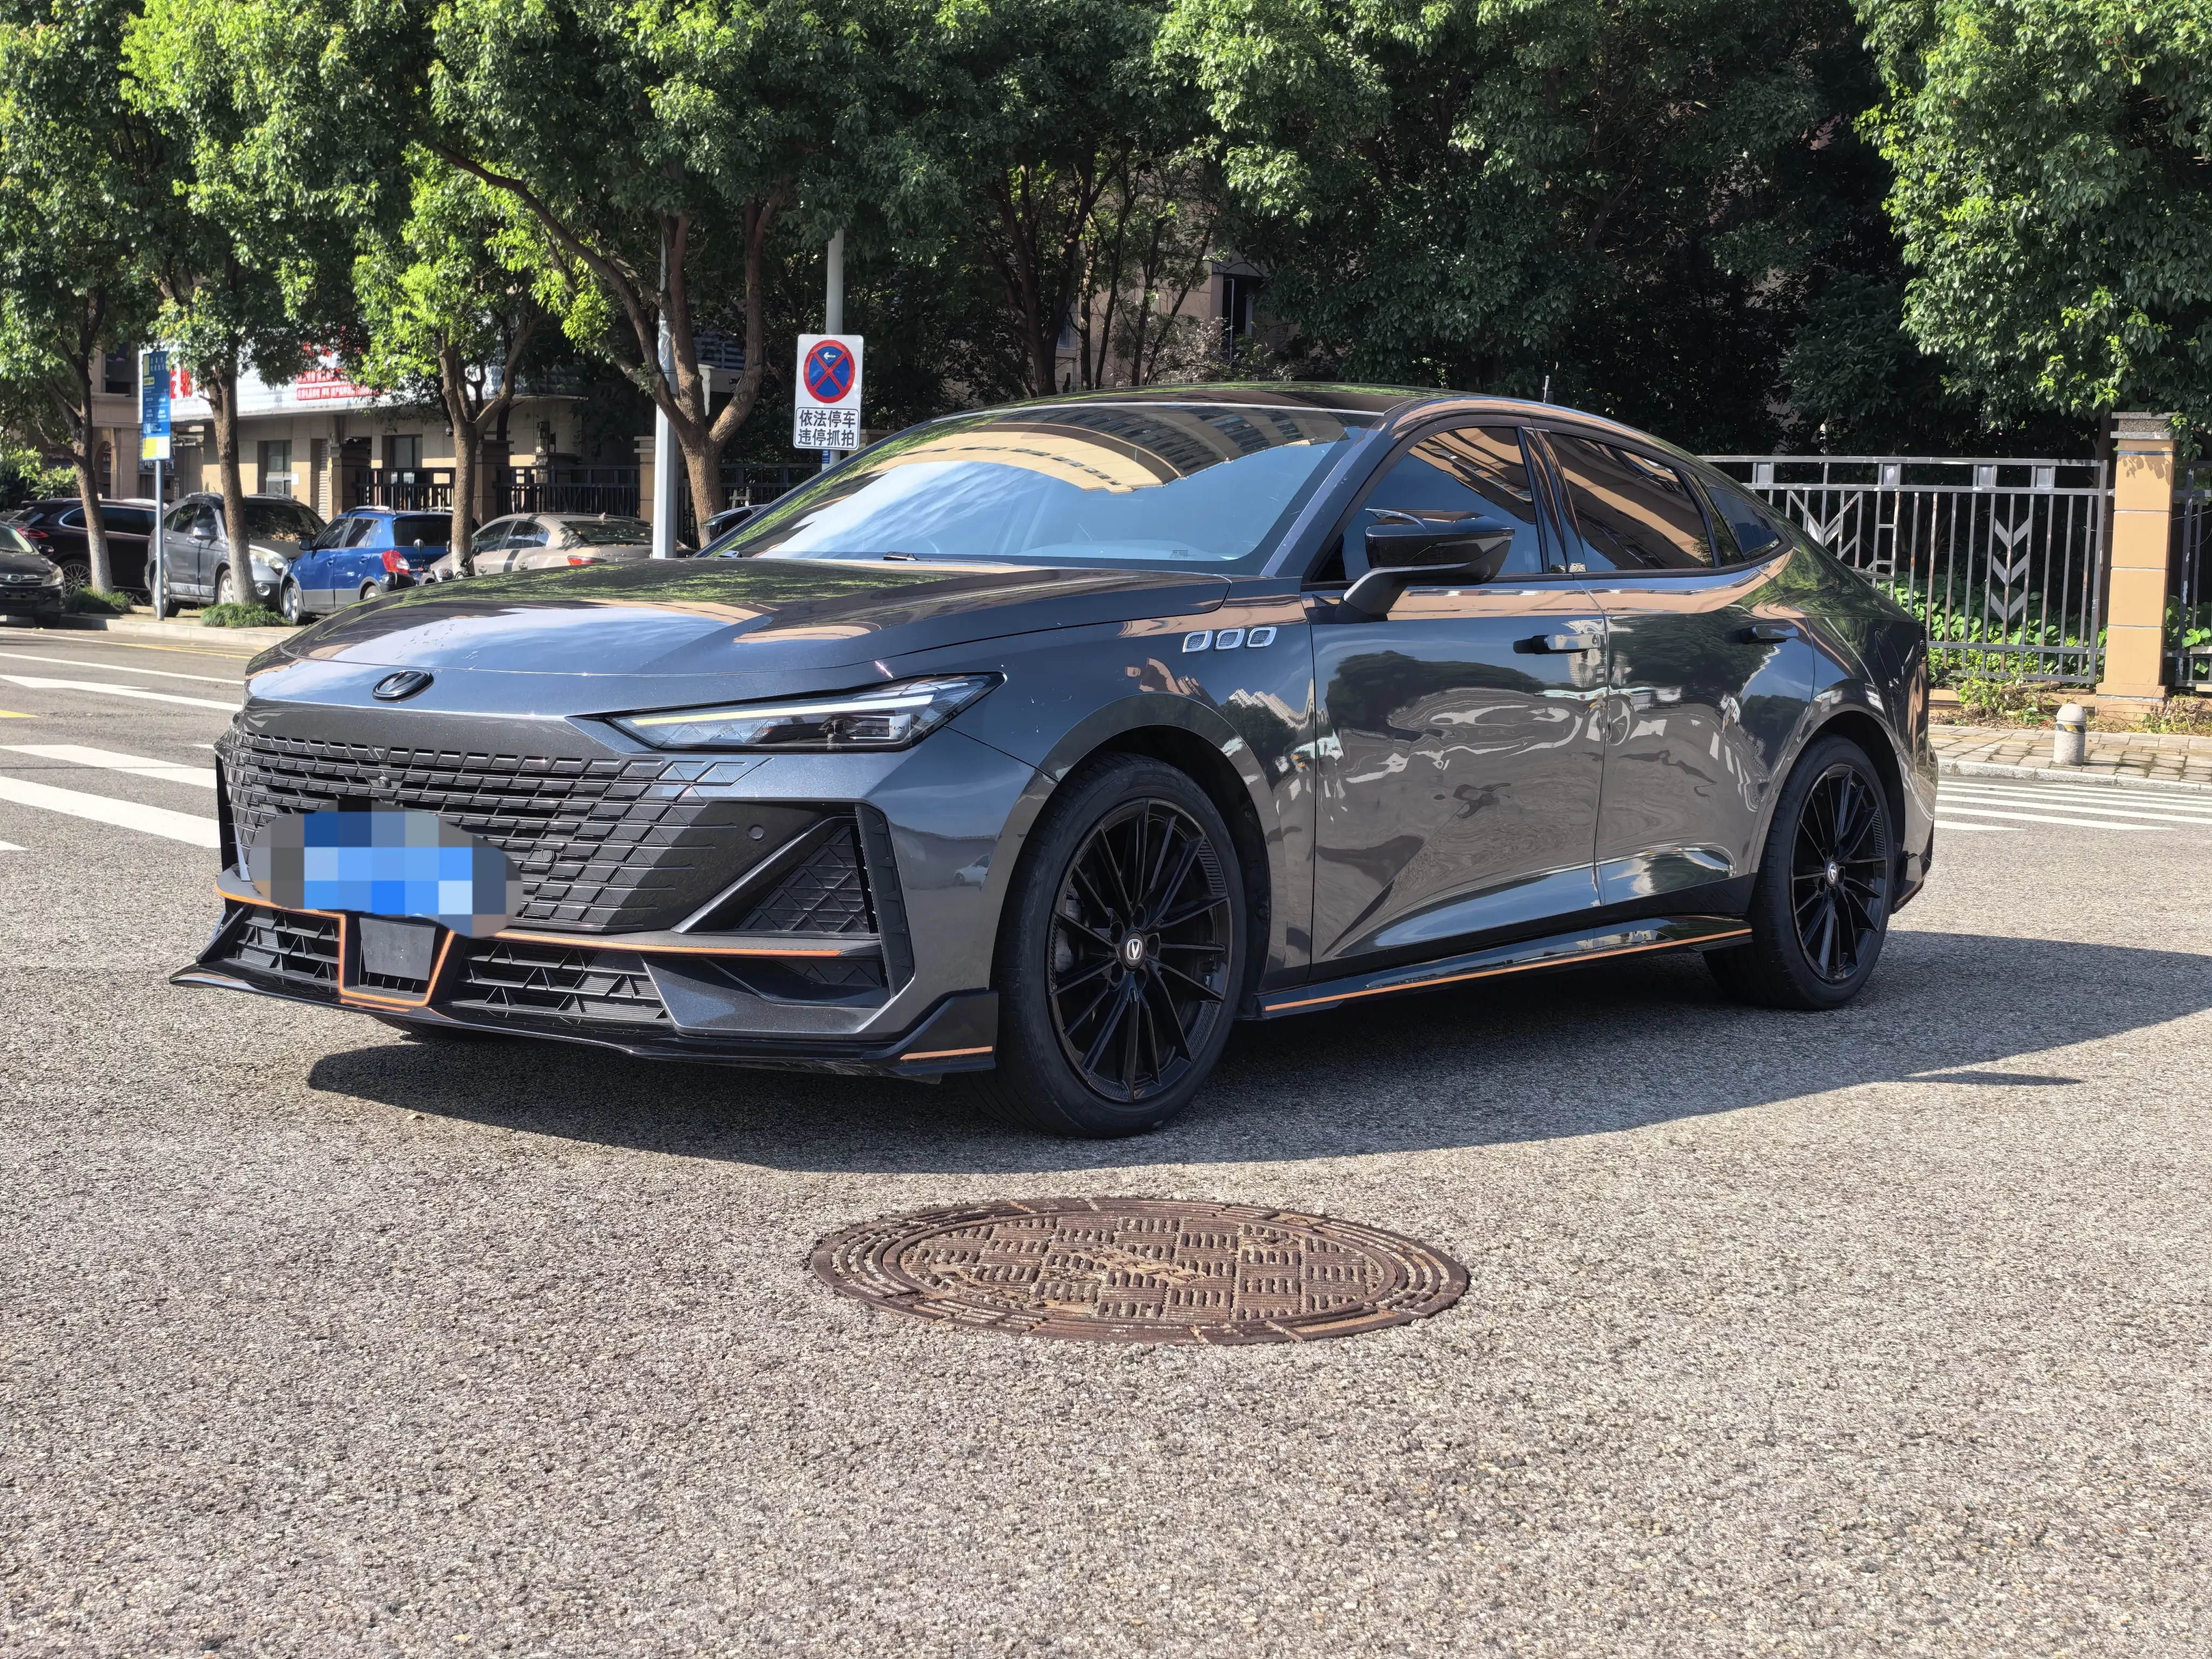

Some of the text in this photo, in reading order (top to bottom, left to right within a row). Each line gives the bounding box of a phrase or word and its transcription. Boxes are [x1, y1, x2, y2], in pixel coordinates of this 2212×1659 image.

[799, 409, 855, 428] 依法停车
[798, 428, 854, 447] 违停抓拍
